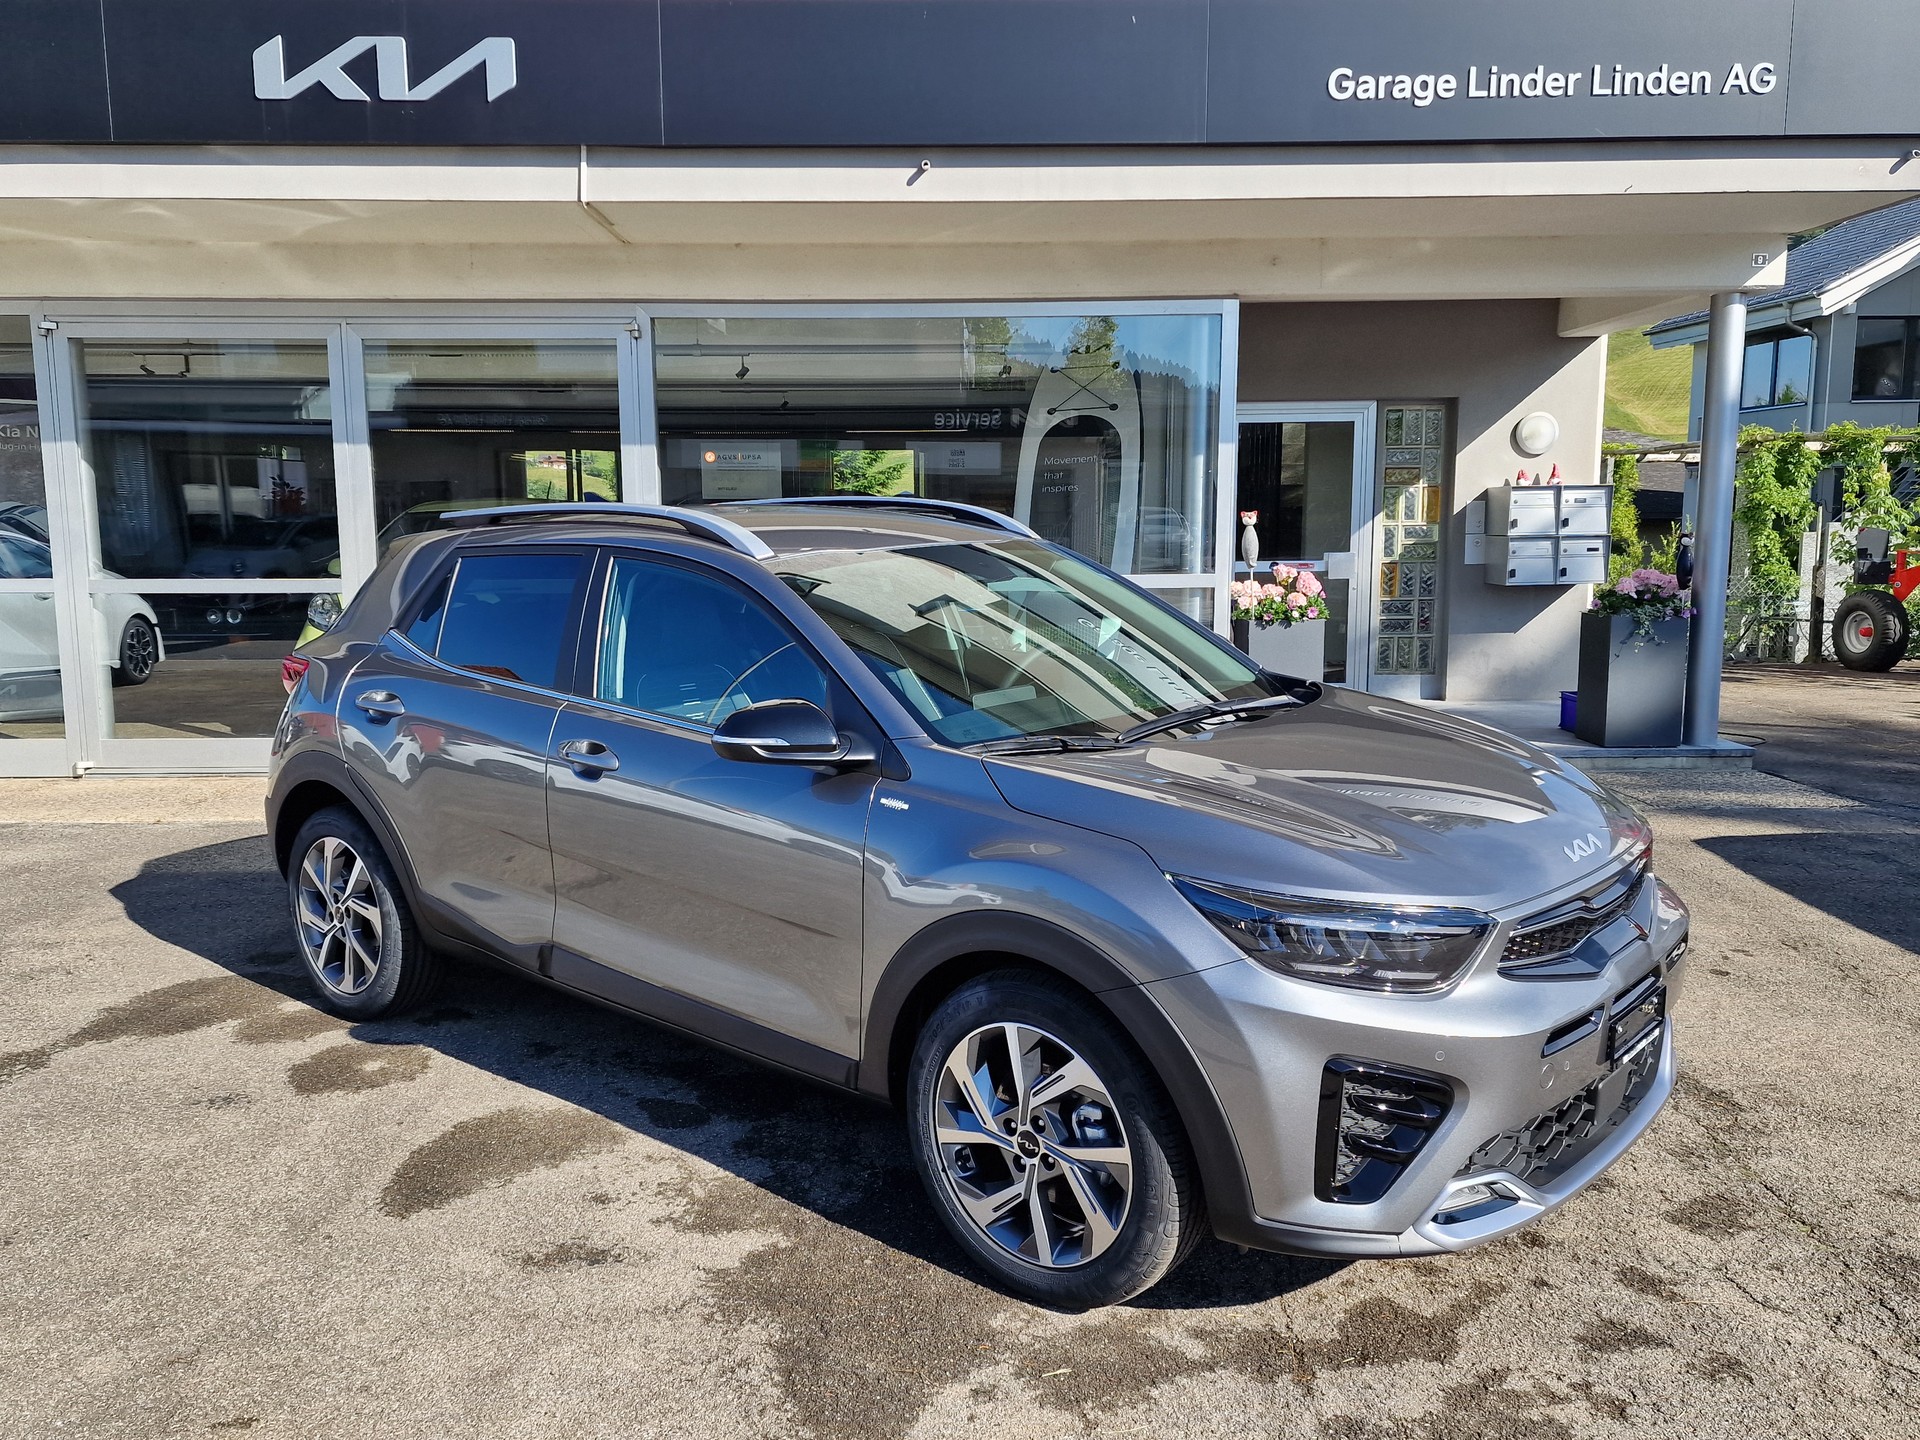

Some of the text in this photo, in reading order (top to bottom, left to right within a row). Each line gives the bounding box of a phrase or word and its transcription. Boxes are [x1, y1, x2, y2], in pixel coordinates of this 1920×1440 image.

[252, 34, 517, 102] KIA
[1327, 62, 1777, 107] Garage Linder Linden AG
[1044, 455, 1098, 466] Movement
[1043, 471, 1064, 480] that
[1041, 483, 1079, 494] inspires
